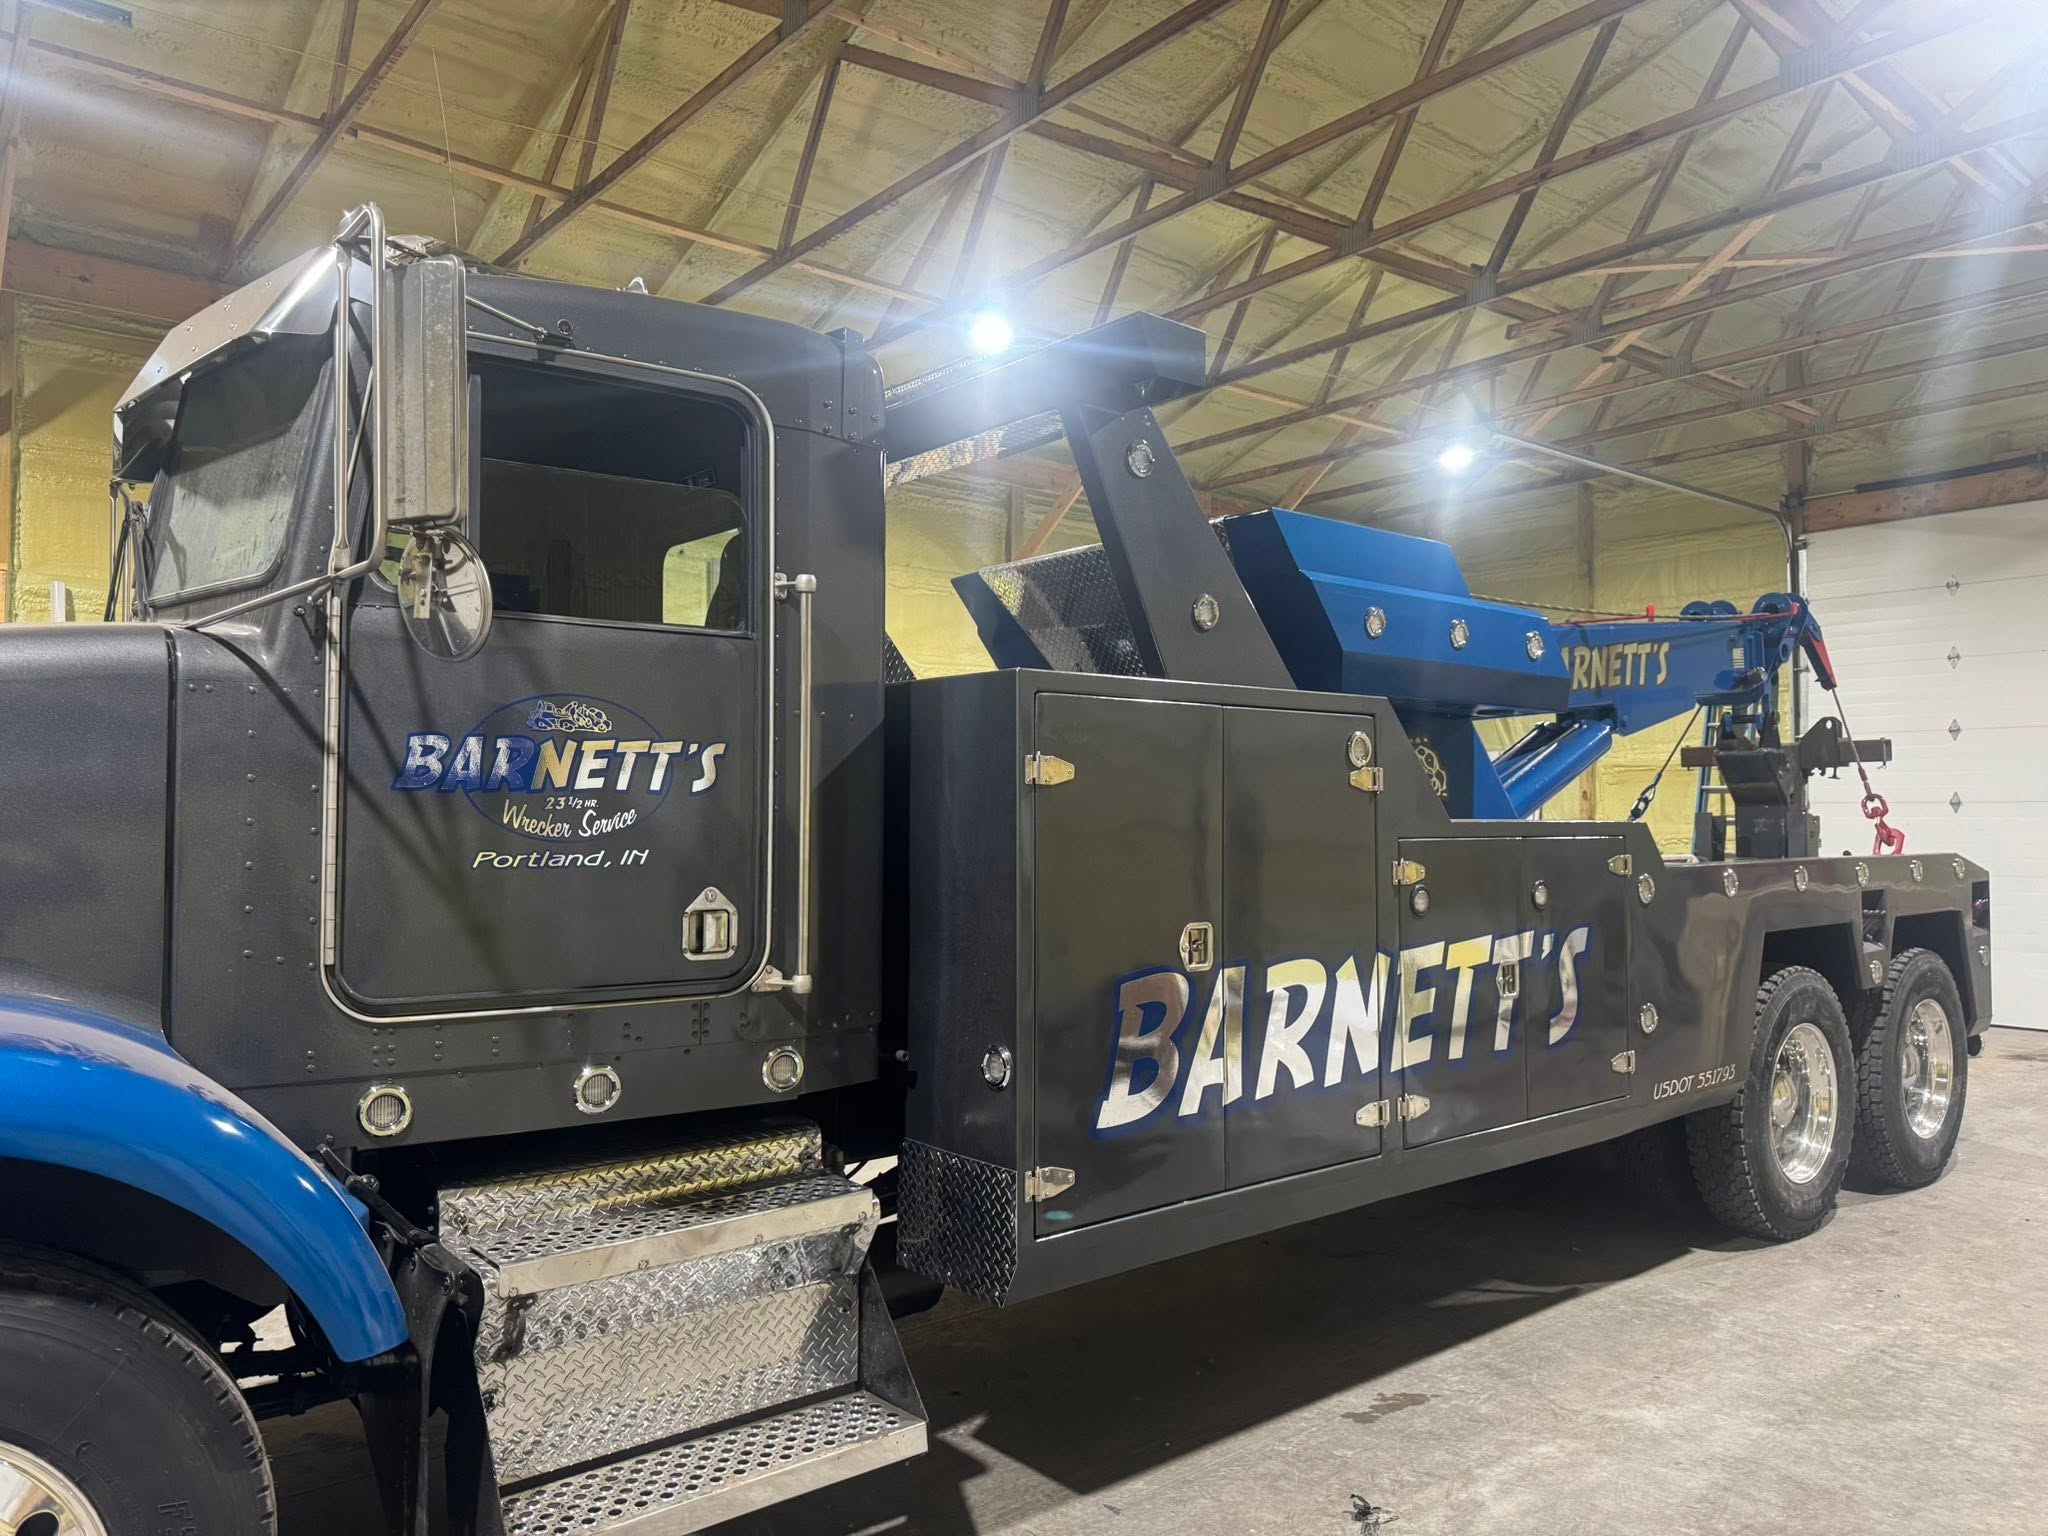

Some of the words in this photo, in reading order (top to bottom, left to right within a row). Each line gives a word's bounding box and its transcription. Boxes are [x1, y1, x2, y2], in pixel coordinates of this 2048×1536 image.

[1561, 641, 1670, 690] RNETT'S
[393, 733, 727, 793] BARNETT'S
[502, 798, 572, 838] Wrecker
[578, 809, 637, 837] Service
[472, 850, 612, 868] Portland,
[620, 849, 650, 866] IN
[1095, 926, 1590, 1131] BARNETT'S
[1653, 1075, 1695, 1100] USDOT
[1697, 1063, 1736, 1089] 551793
